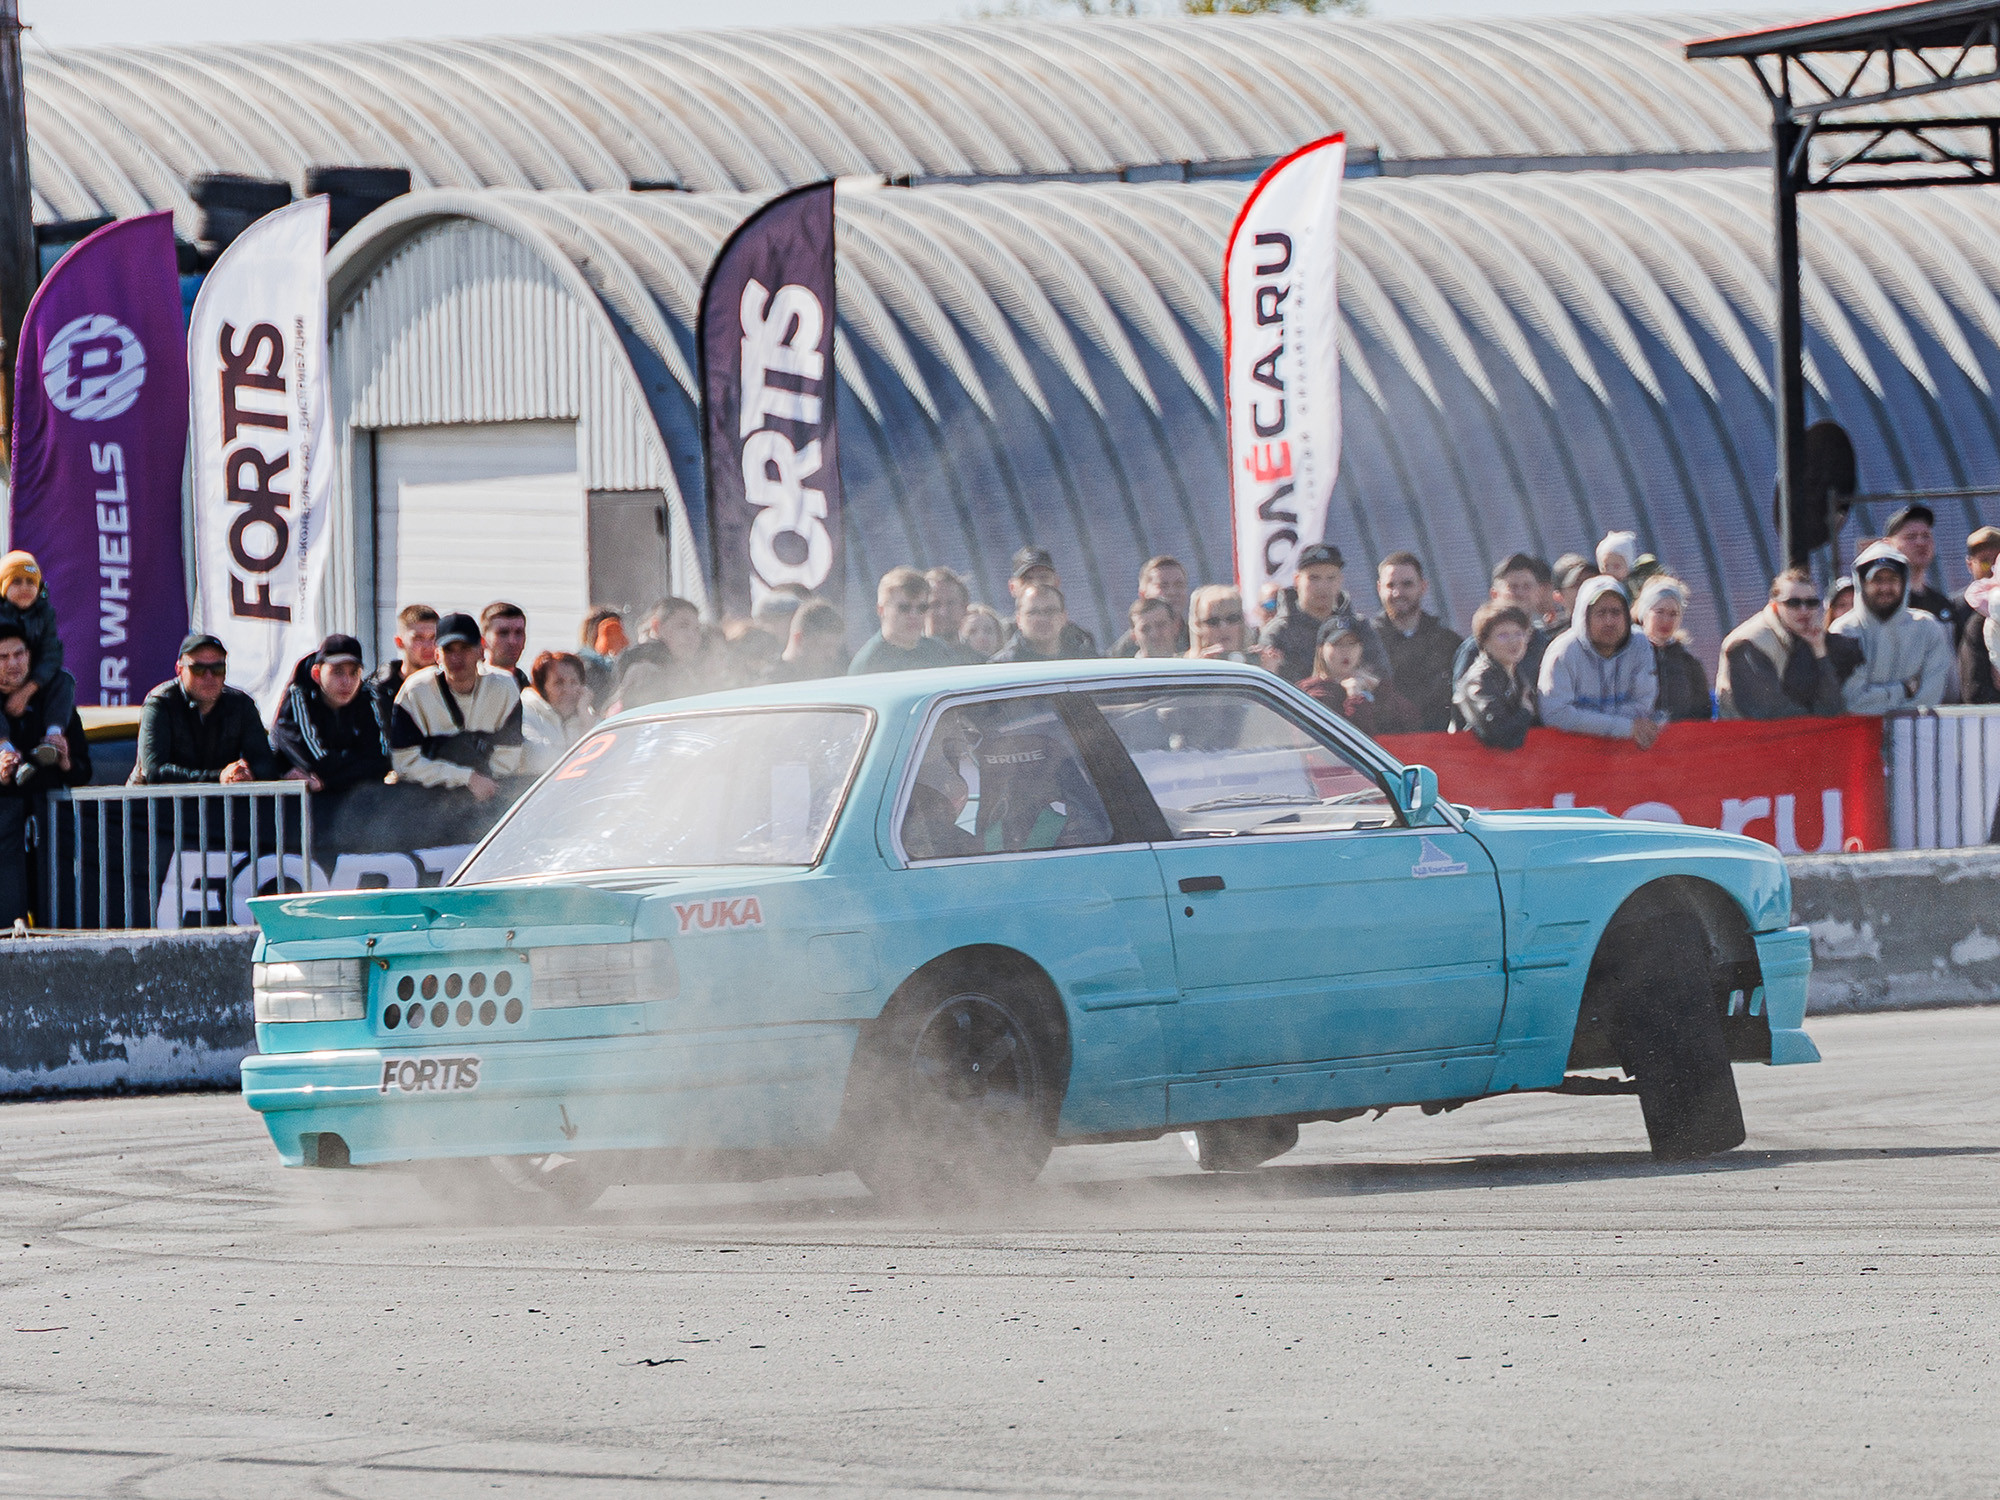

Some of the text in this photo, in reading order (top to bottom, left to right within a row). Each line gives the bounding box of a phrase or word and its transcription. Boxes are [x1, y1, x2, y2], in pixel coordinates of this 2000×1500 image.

[219, 320, 292, 624] FORTIS
[90, 441, 131, 647] WHEELS
[554, 733, 617, 781] 2
[674, 897, 762, 931] YUKA
[381, 1057, 480, 1092] FORTIS
